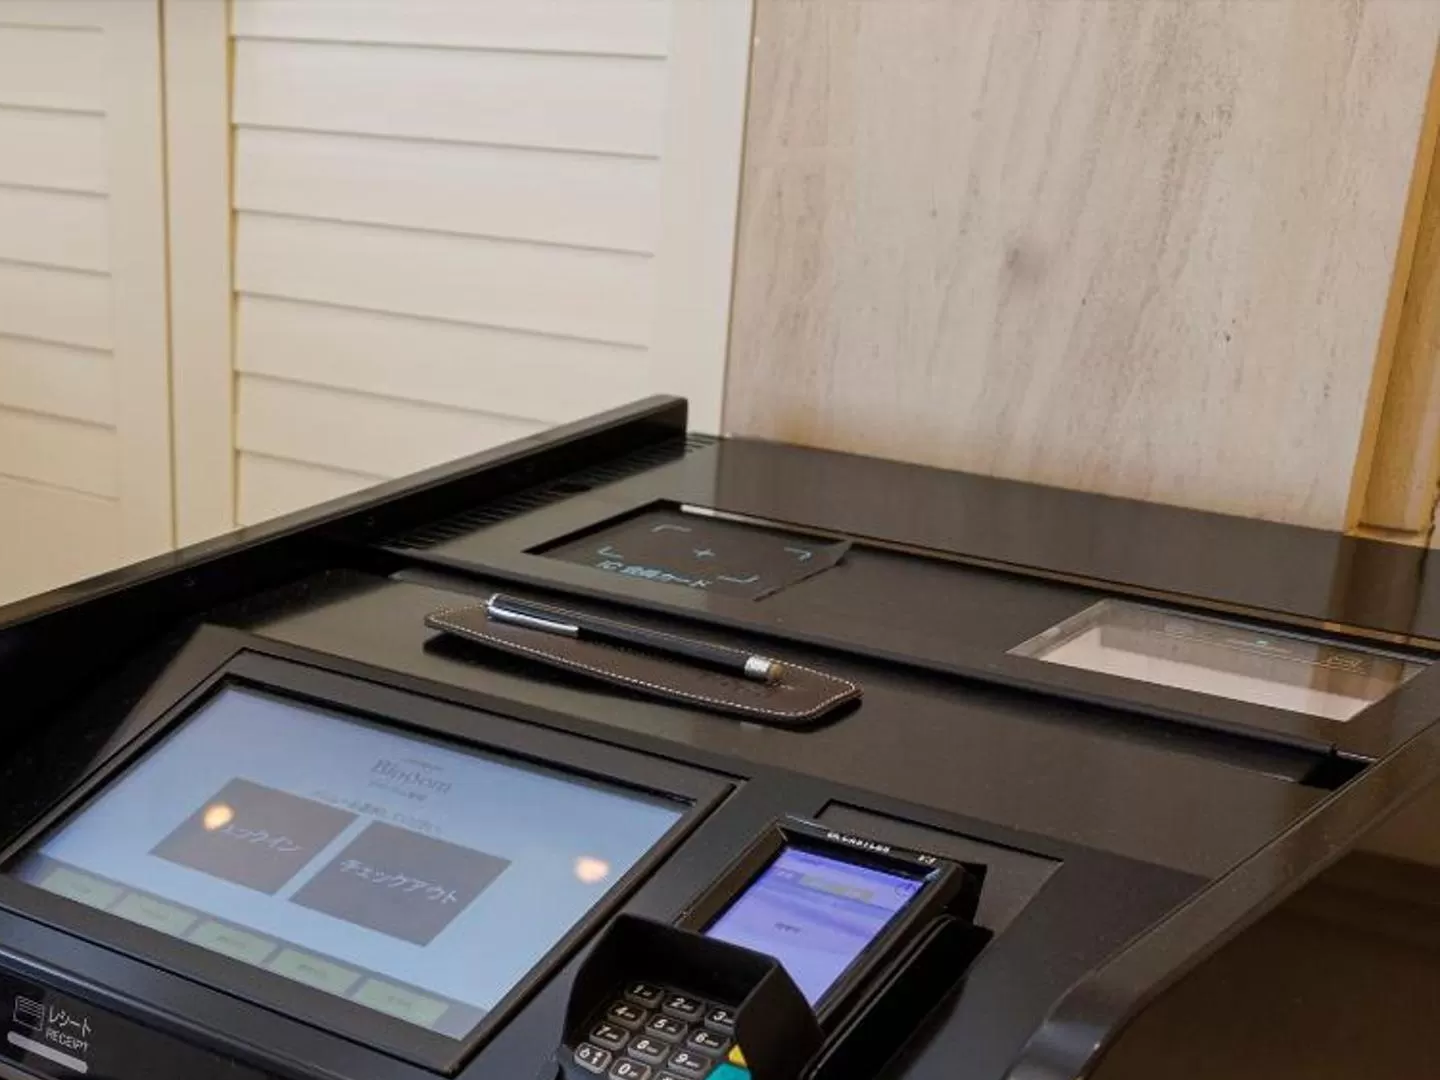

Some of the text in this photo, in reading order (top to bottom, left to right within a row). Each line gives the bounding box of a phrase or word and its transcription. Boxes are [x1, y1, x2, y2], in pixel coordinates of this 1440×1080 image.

[48, 1003, 93, 1038] レシート
[45, 1026, 89, 1053] RECEIPT
